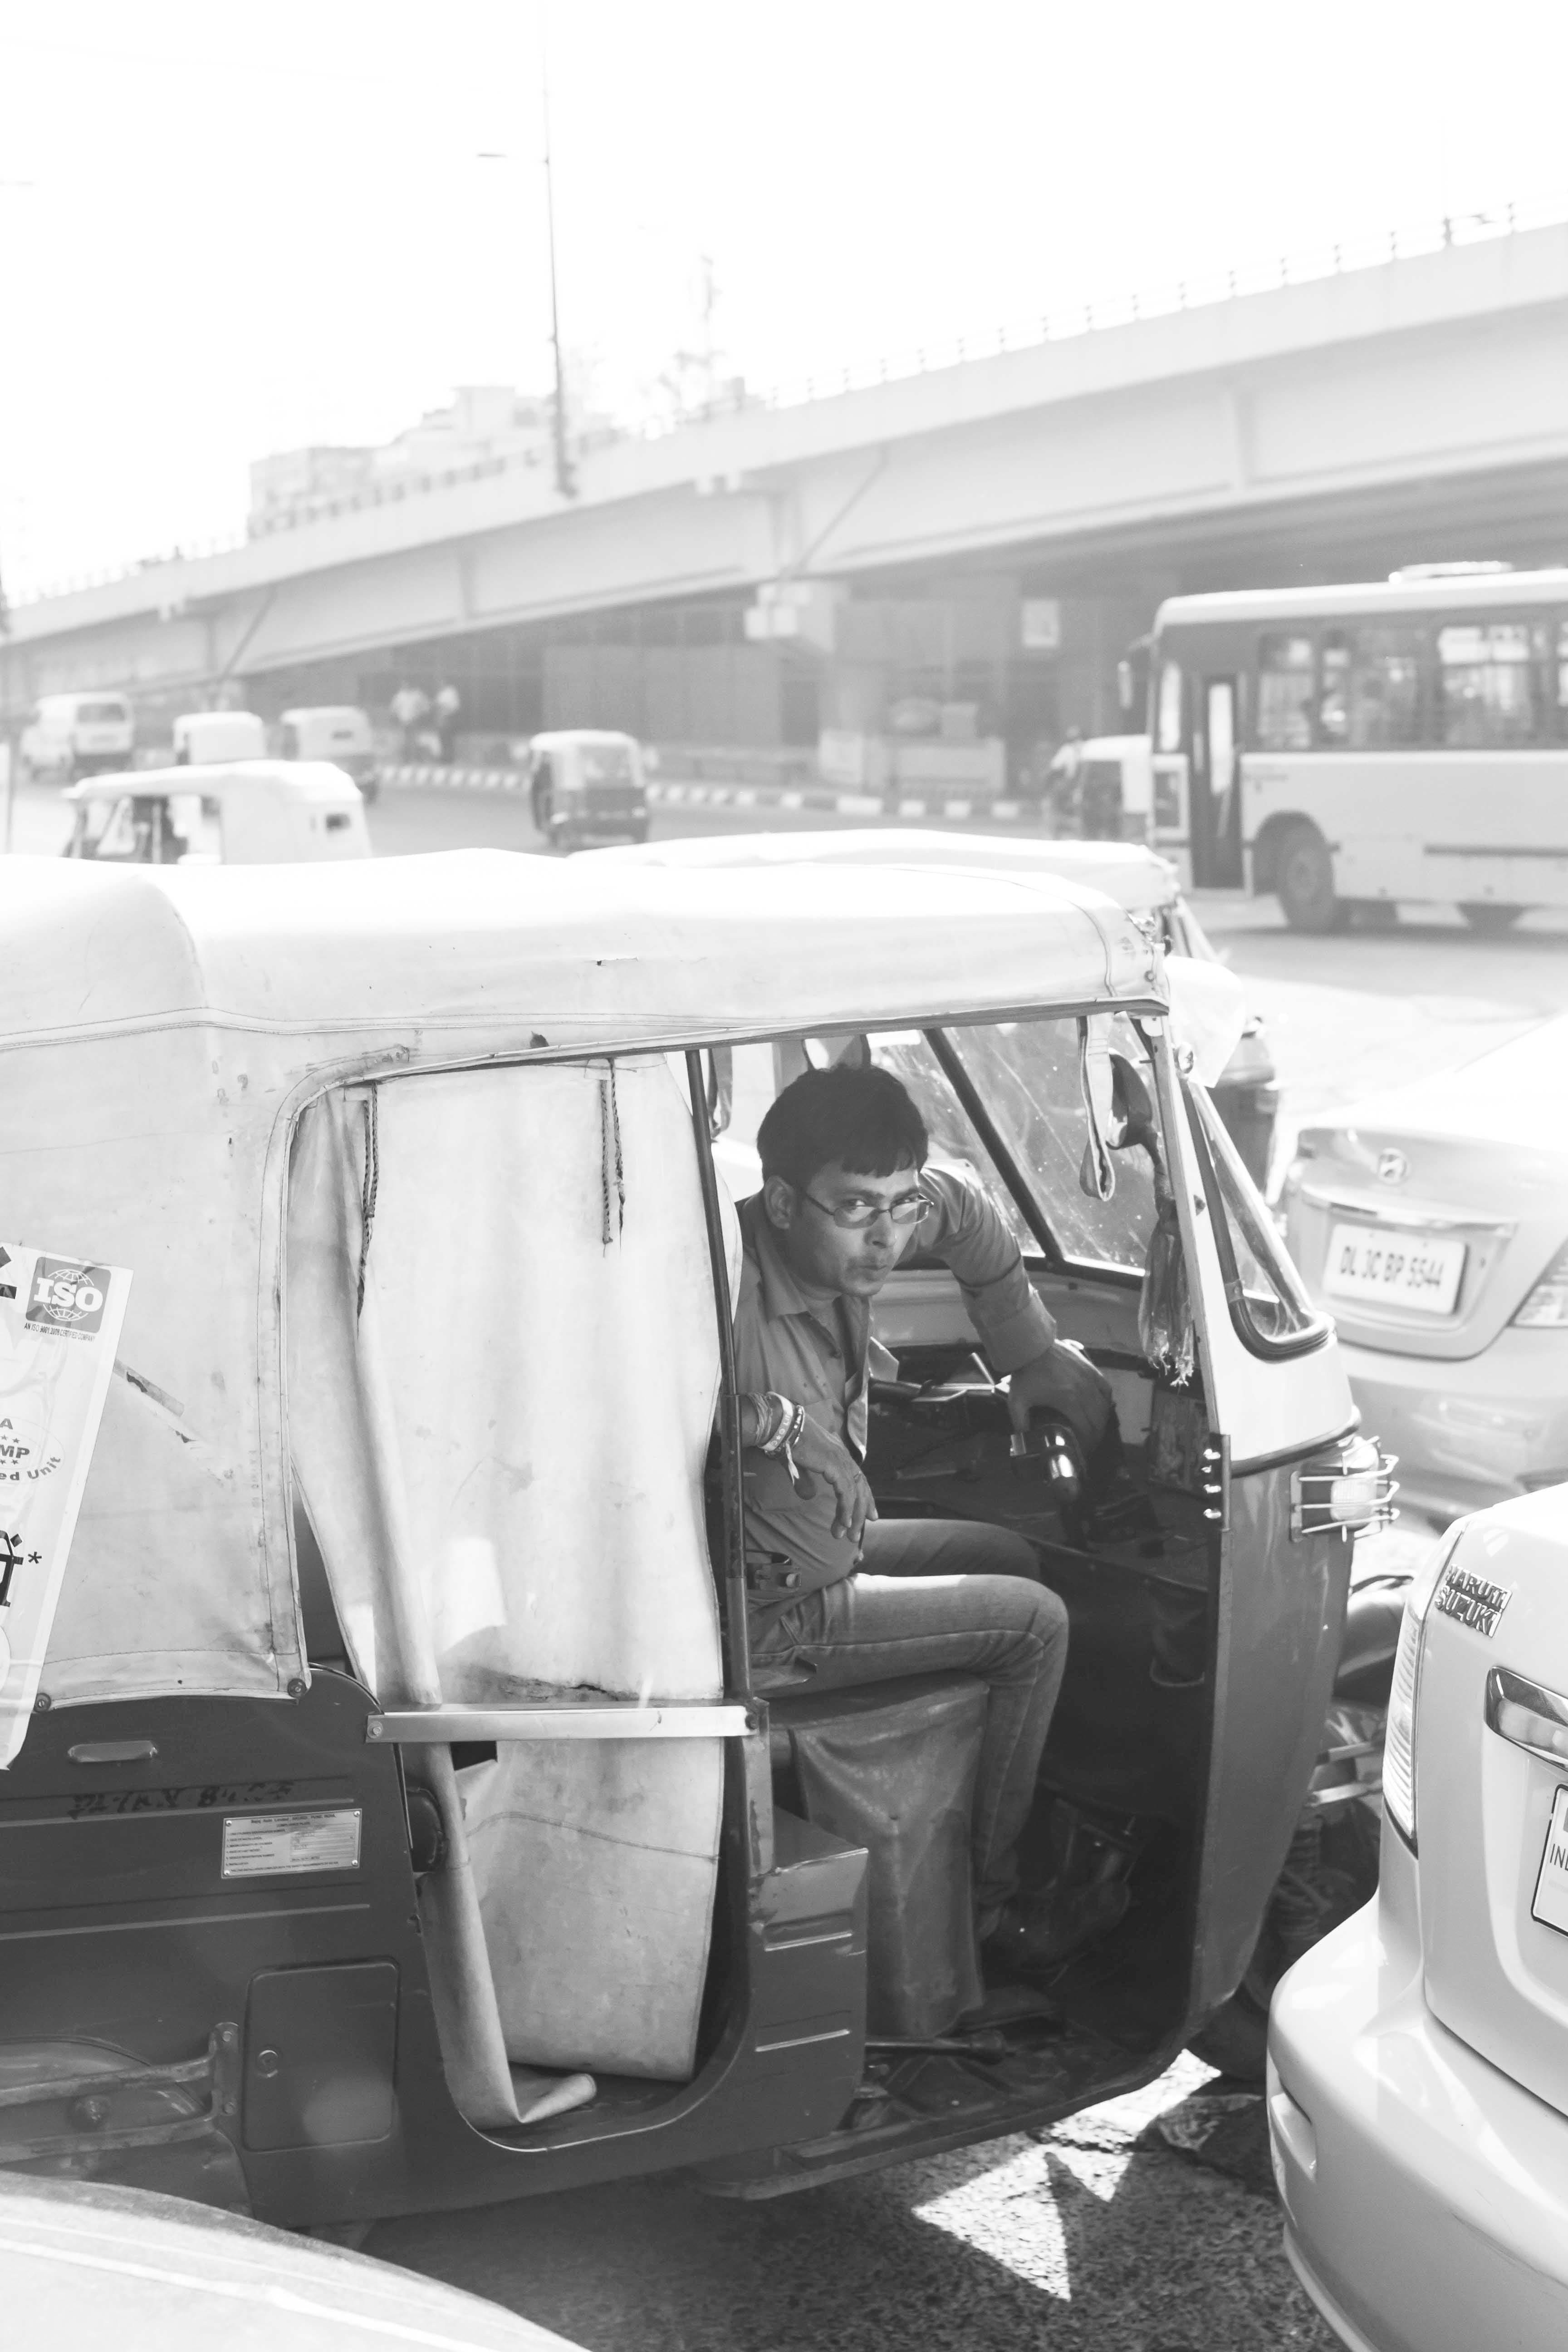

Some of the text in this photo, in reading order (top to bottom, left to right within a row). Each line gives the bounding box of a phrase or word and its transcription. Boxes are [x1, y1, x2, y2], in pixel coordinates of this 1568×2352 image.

[34, 1277, 103, 1312] ISO
[24, 1322, 32, 1330] AN
[31, 1323, 40, 1332] ISO
[0, 1444, 30, 1459] MP
[27, 1456, 61, 1480] Unit
[1445, 1563, 1513, 1610] MARUTI
[1434, 1584, 1502, 1638] SUZUKI
